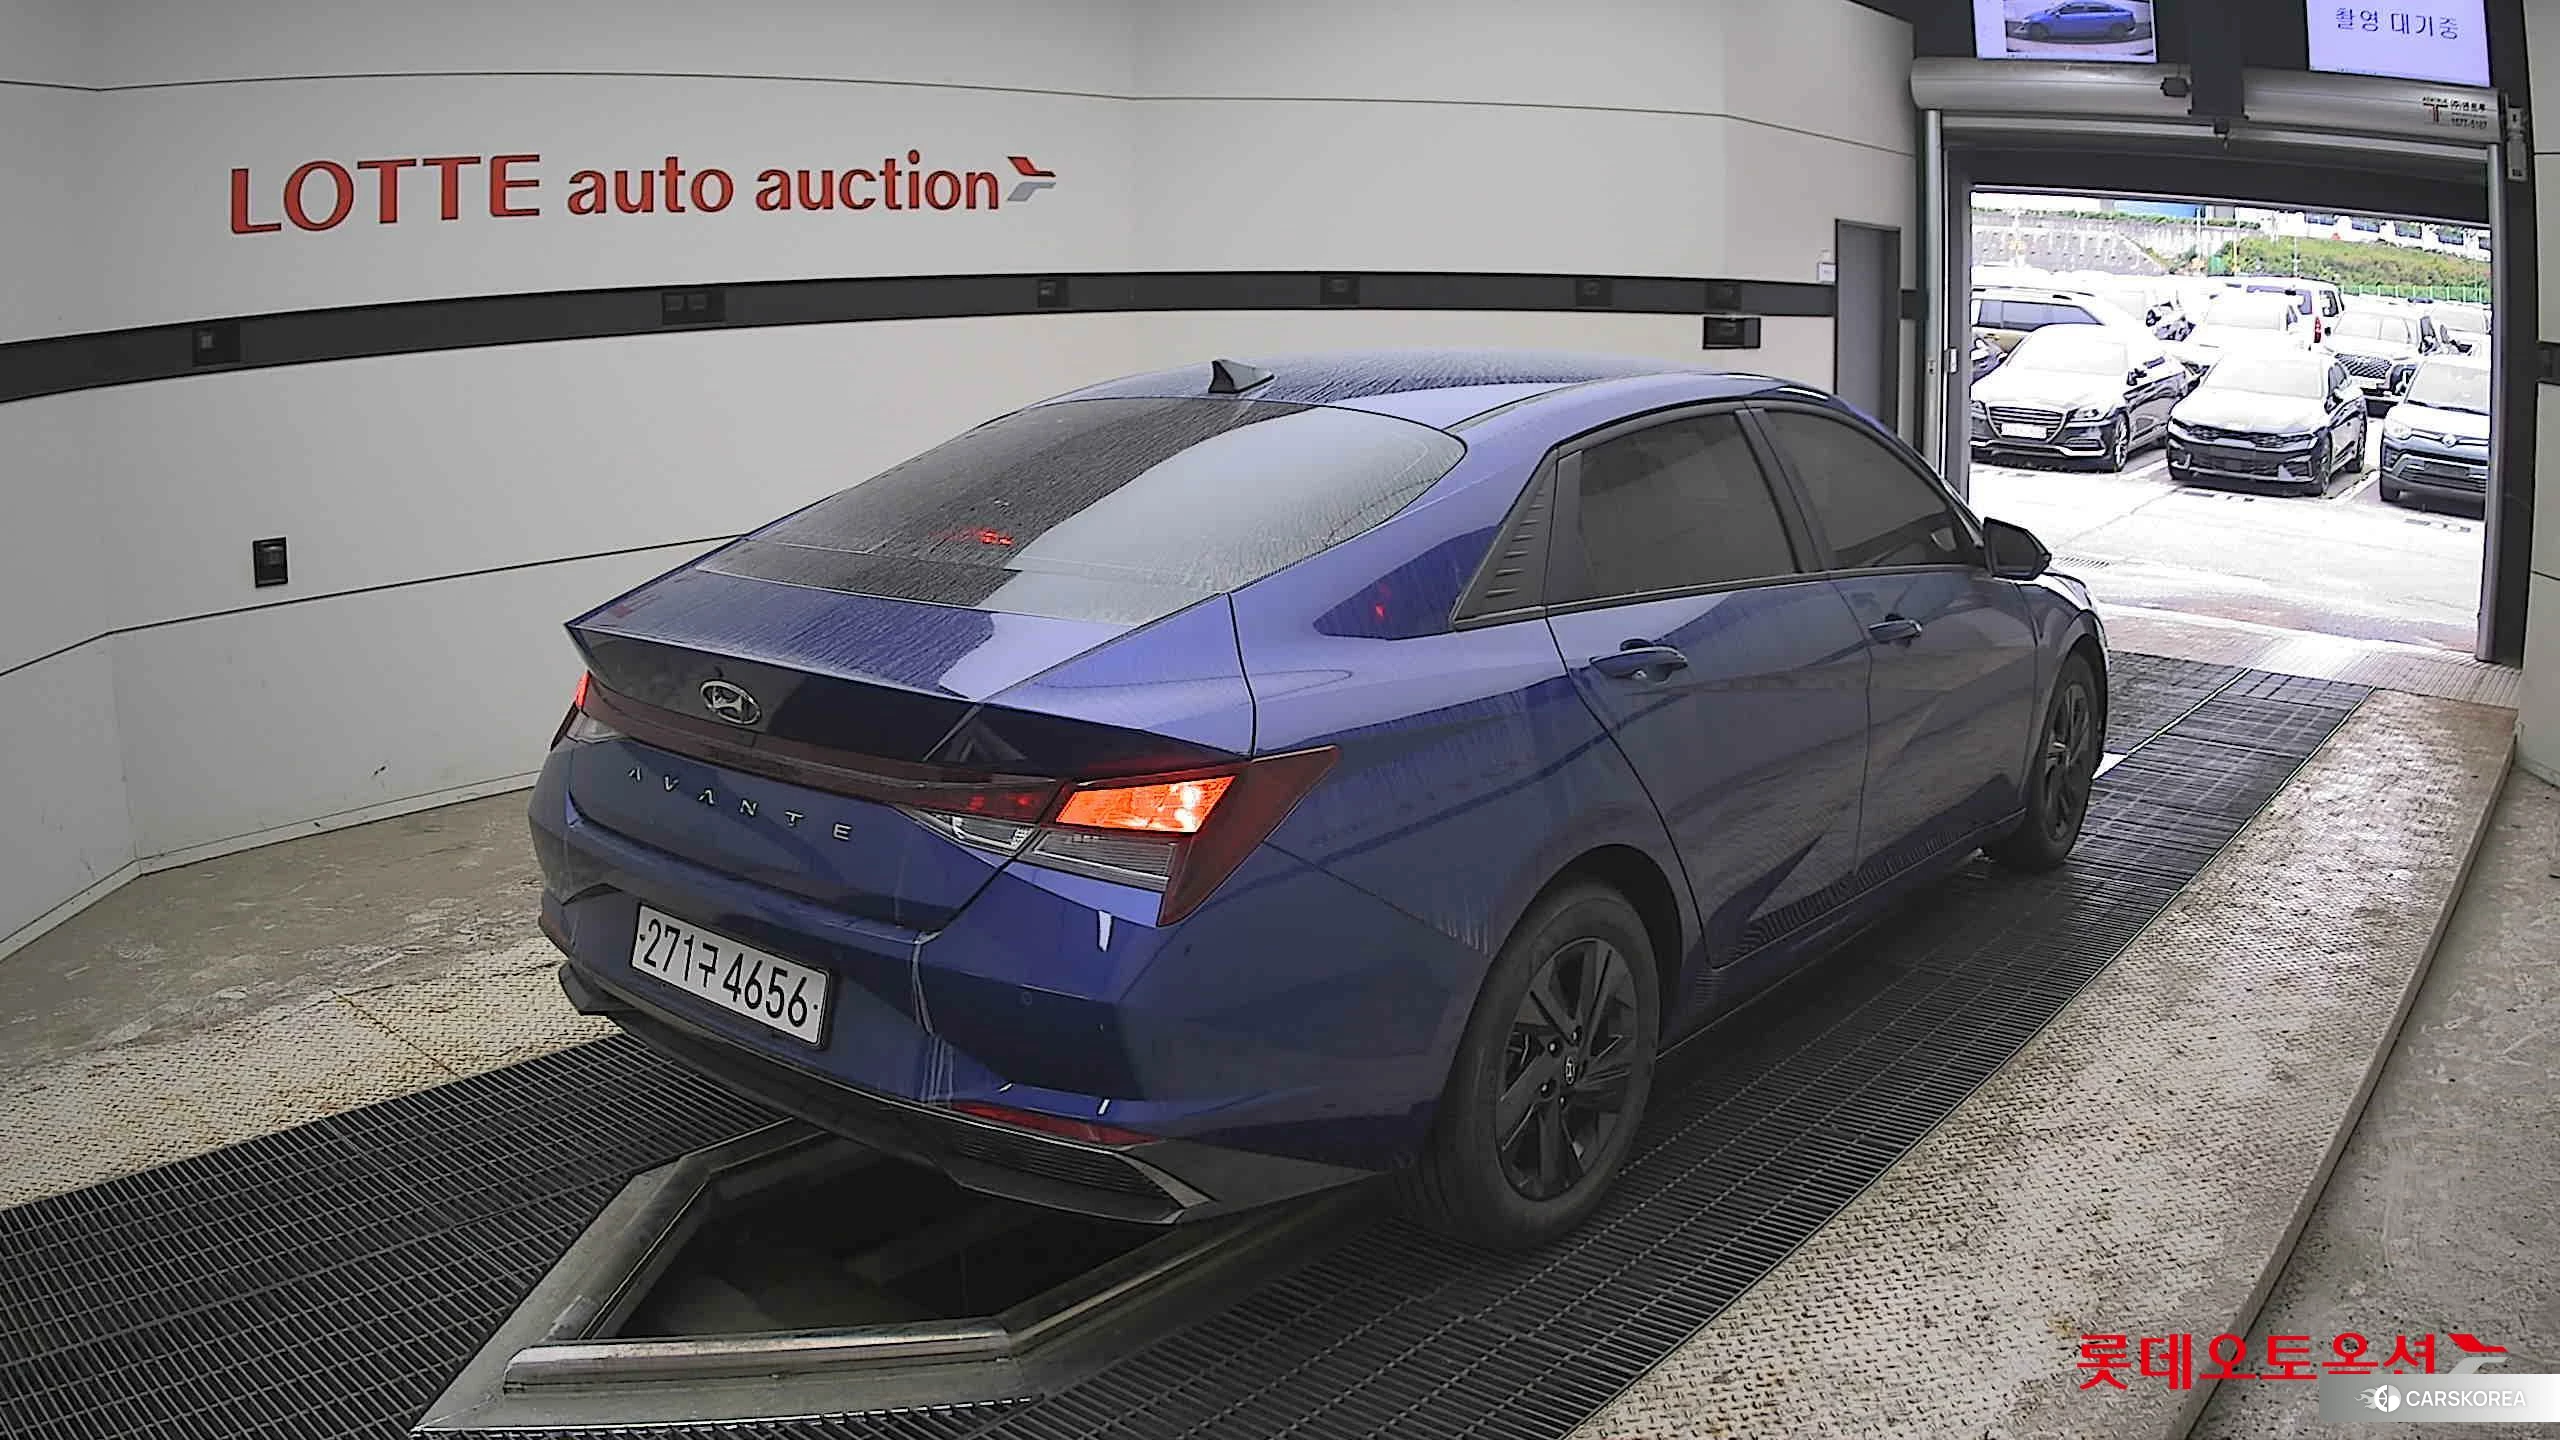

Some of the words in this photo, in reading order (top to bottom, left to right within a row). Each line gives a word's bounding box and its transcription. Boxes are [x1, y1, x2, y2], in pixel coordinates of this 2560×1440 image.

[2335, 7, 2380, 33] 촬영
[2389, 12, 2460, 41] 대기중
[231, 154, 541, 234] LOTTE
[566, 156, 735, 215] auto
[754, 150, 1000, 212] auction
[627, 766, 853, 841] AVANTE
